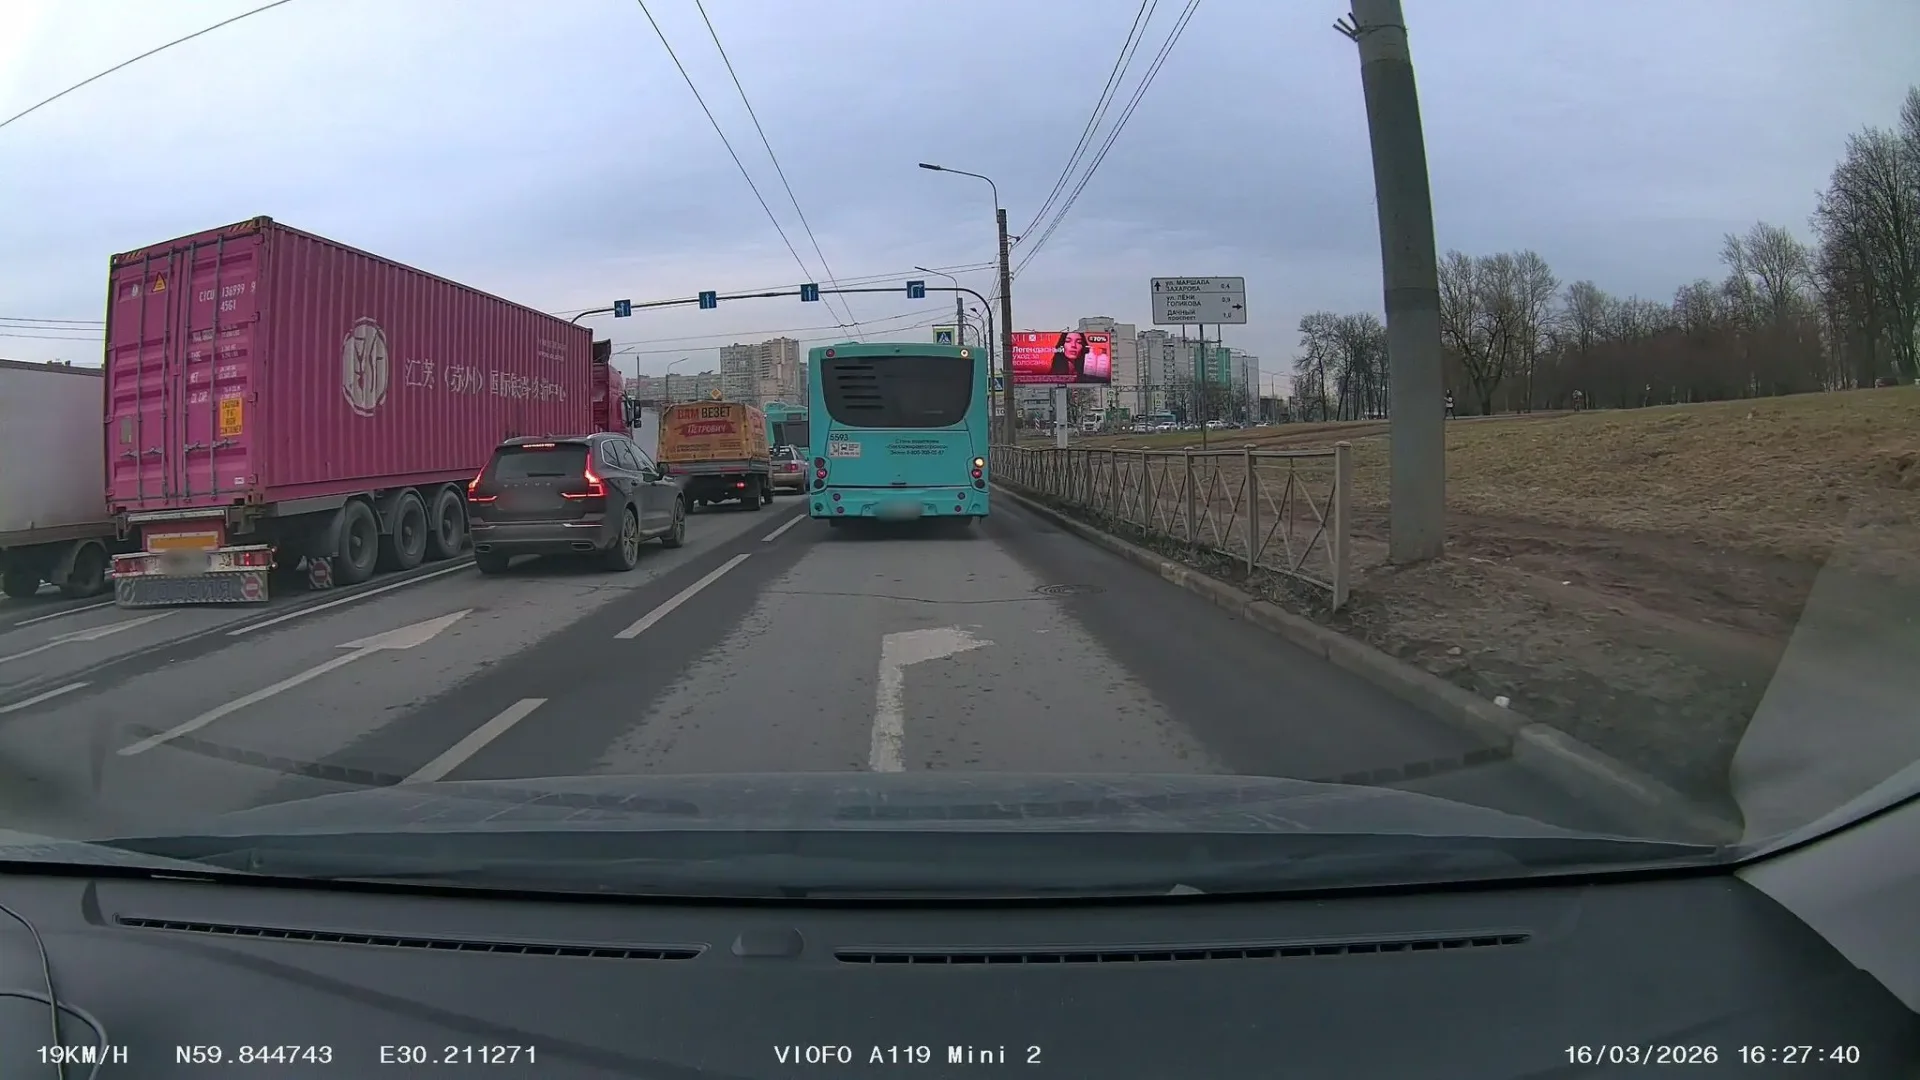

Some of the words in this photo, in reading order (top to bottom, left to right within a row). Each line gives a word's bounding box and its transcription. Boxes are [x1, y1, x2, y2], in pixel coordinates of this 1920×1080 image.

[1012, 345, 1065, 353] Легендарный
[676, 407, 699, 420] ВАМ
[686, 424, 727, 434] ПЕТРОВИЧ
[829, 433, 849, 441] 5593
